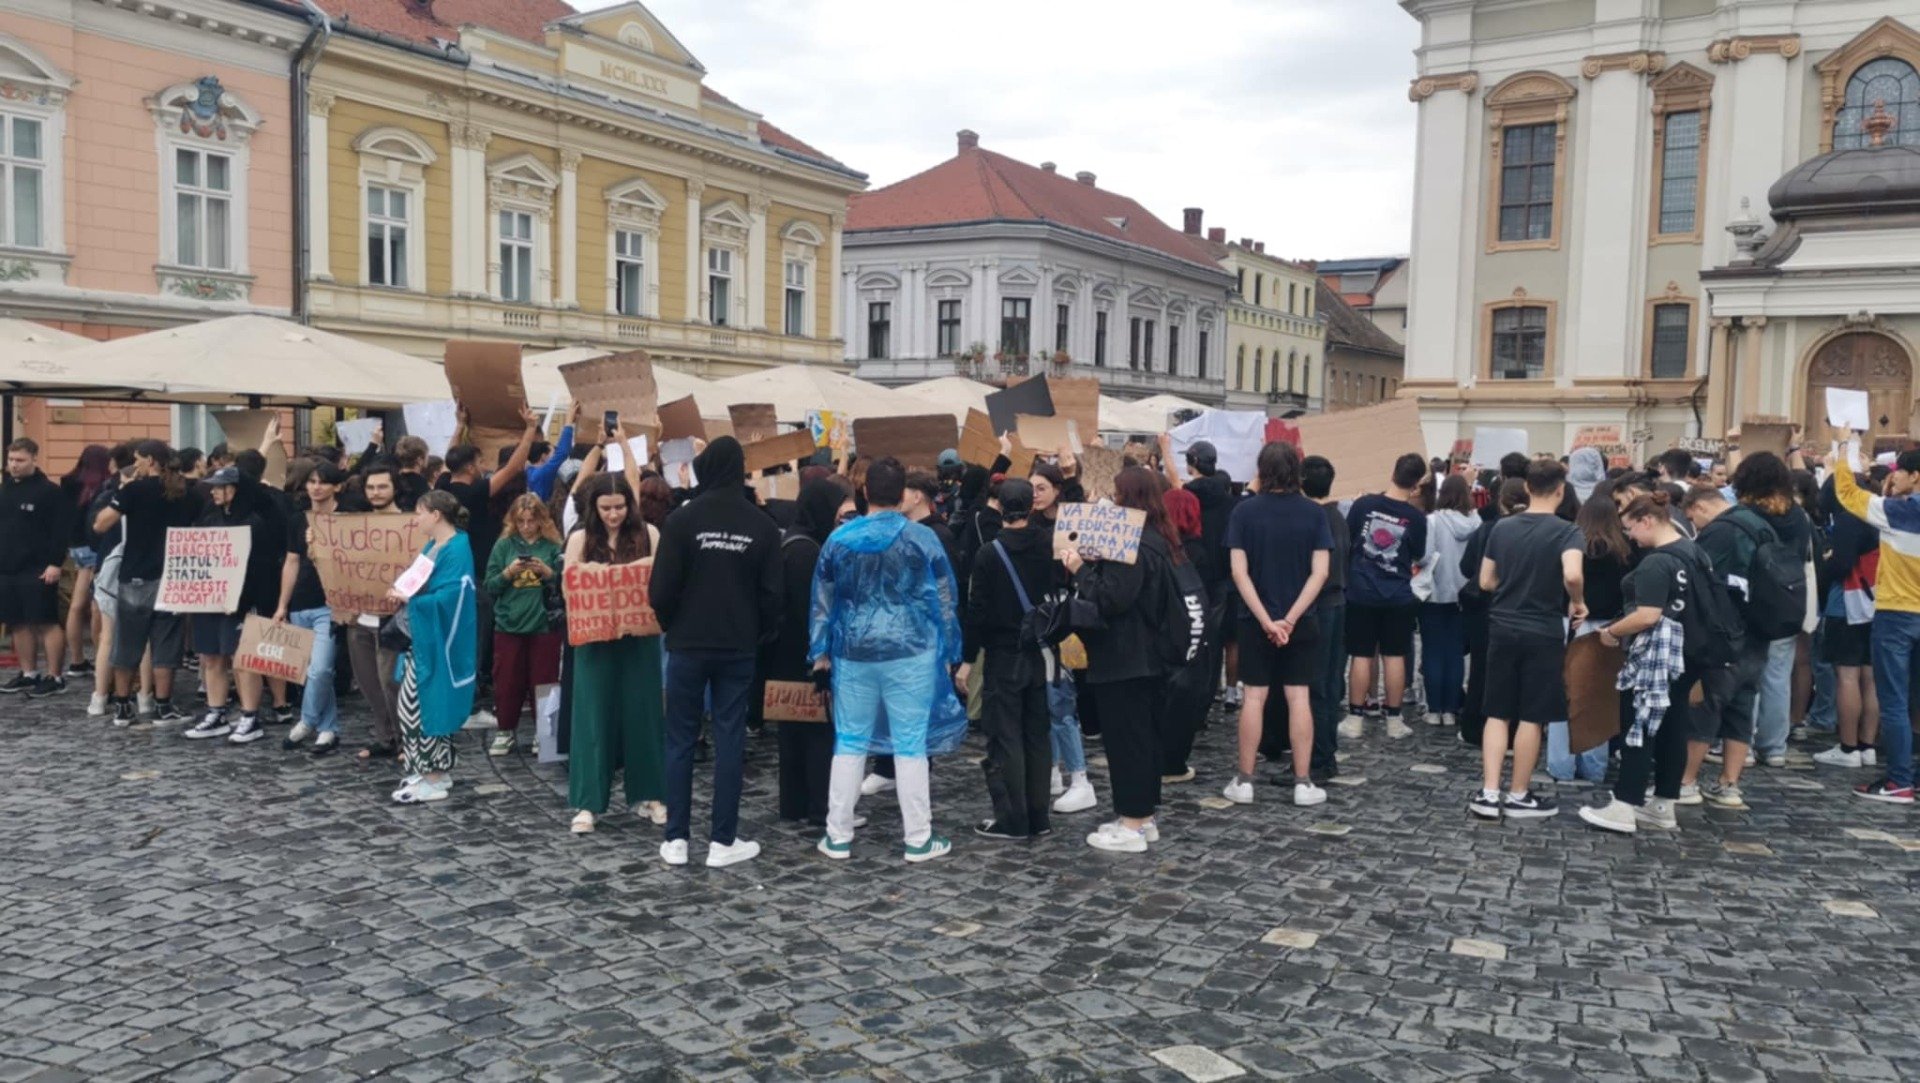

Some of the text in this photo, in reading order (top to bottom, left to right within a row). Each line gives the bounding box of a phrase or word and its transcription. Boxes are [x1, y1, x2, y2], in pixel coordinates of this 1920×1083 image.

[1063, 504, 1081, 516] VA
[1057, 520, 1072, 531] DE
[314, 511, 419, 553] Student
[1124, 540, 1137, 551] VA
[332, 548, 405, 584] Prezen
[166, 569, 212, 580] STATUL
[570, 593, 594, 611] NU
[615, 588, 648, 610] DO
